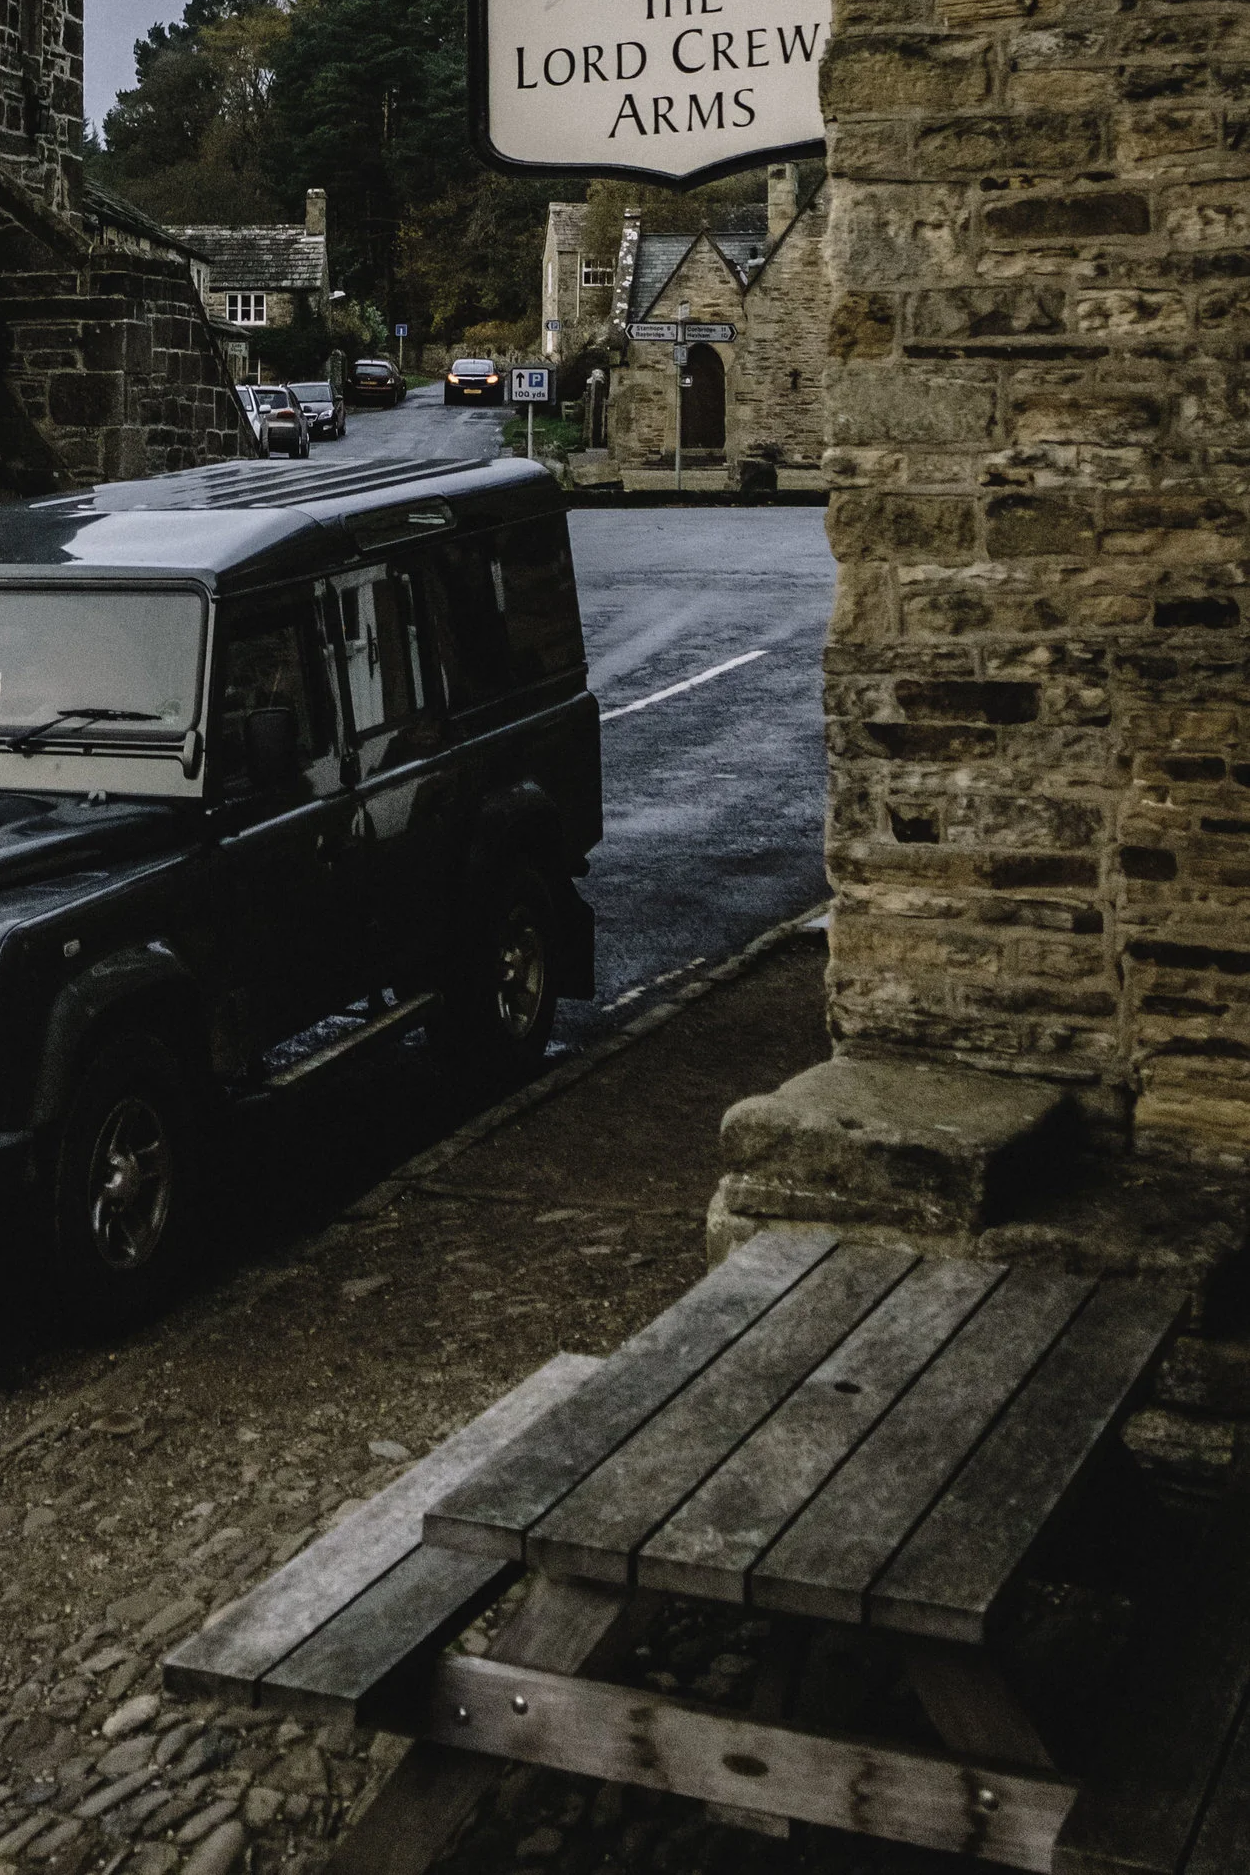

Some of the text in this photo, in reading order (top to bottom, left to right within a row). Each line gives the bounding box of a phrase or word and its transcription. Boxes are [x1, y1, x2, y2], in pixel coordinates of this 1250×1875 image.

[515, 39, 648, 90] LORD
[607, 87, 757, 139] ARMS
[514, 390, 546, 399] 100 yds
